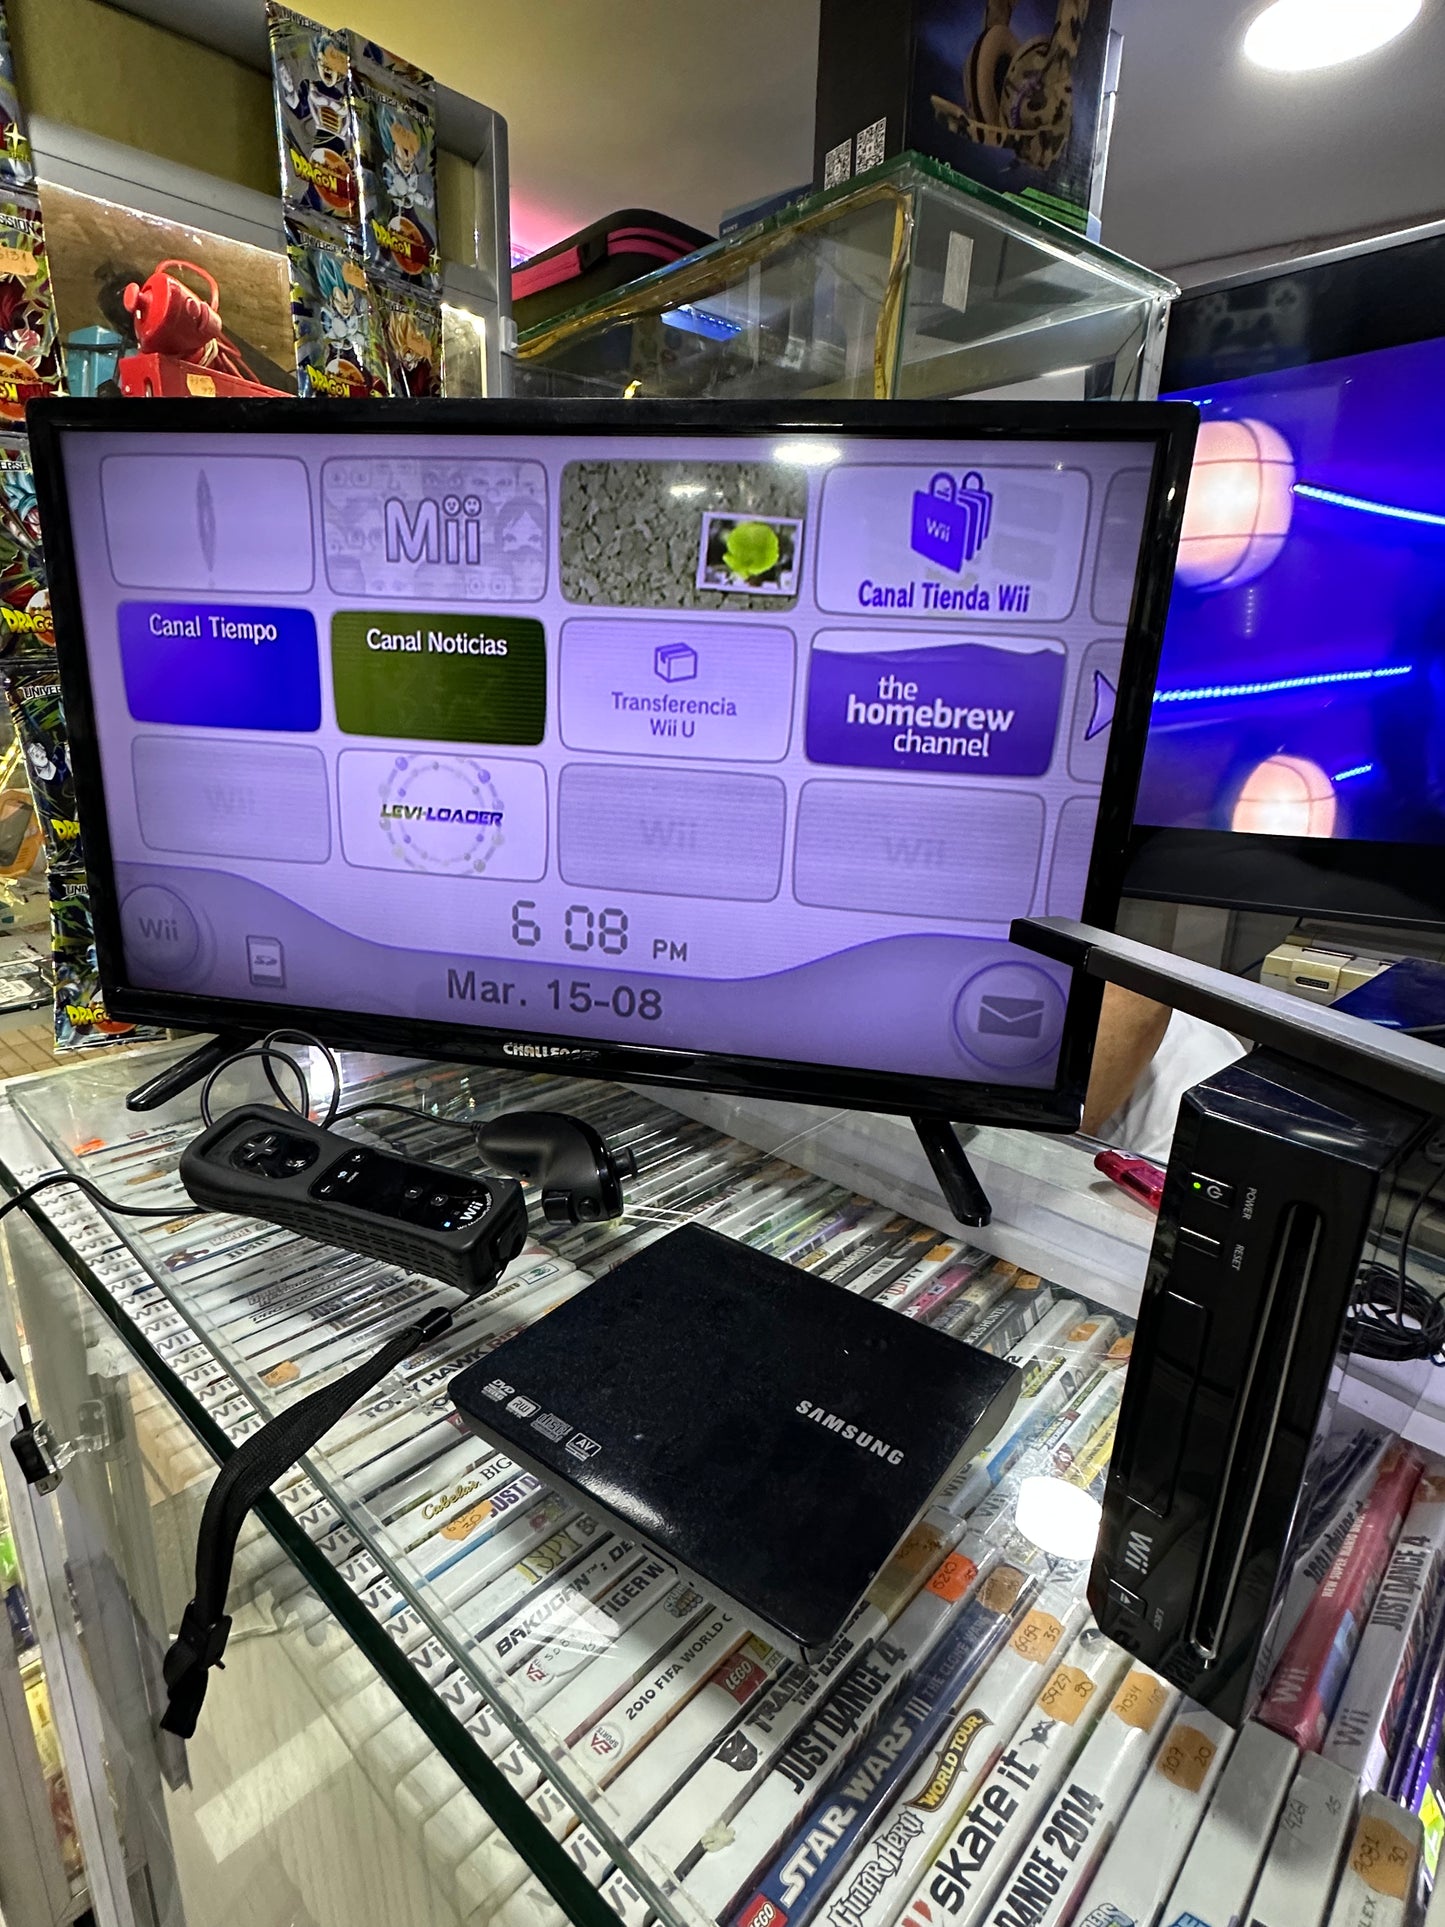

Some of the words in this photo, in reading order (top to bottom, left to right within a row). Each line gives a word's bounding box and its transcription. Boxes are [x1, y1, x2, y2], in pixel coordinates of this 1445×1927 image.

[290, 149, 338, 193] DRAGON
[0, 214, 35, 236] SSION
[371, 219, 412, 258] DRAGON
[307, 365, 350, 397] DRAGON
[384, 494, 482, 565] Mii
[926, 517, 952, 543] Wii
[858, 580, 915, 609] Canal
[922, 583, 990, 611] Tienda
[998, 586, 1030, 614] Wii
[1, 606, 54, 634] DRAGO
[149, 614, 201, 638] Canal
[209, 616, 278, 645] Tiempo
[366, 628, 421, 653] Canal
[428, 632, 508, 656] Noticias
[611, 693, 738, 718] Transferencia
[878, 677, 918, 701] the
[650, 719, 678, 738] Wii
[681, 720, 695, 739] U
[847, 693, 1014, 733] homebrew
[893, 731, 990, 759] channel
[51, 819, 80, 841] DRA
[138, 916, 179, 943] Wii
[652, 938, 688, 963] PM
[447, 968, 527, 1007] Mar.
[546, 978, 663, 1021] 15-08
[65, 1004, 112, 1027] DRAG
[460, 1201, 484, 1221] Wii
[1242, 1186, 1258, 1220] POWER
[1232, 1243, 1245, 1271] RESET
[421, 1348, 488, 1387] HAWK
[492, 1379, 516, 1394] DVD
[575, 1438, 596, 1451] AV
[796, 1400, 904, 1466] SAMSUNG
[479, 1457, 513, 1481] BIG
[489, 1482, 527, 1518] JUST
[1125, 1530, 1153, 1575] Wii
[1401, 1535, 1431, 1548] 4
[1382, 1550, 1428, 1595] DANCE
[599, 1572, 648, 1618] TIGER
[1370, 1592, 1411, 1632] JUST
[626, 1689, 656, 1721] 2010
[654, 1664, 684, 1691] FIFA
[681, 1619, 724, 1664] WORLD
[725, 1660, 753, 1691] LEGO
[774, 1726, 838, 1795] JUST
[816, 1662, 892, 1739] DANCE
[876, 1639, 908, 1667] 4
[1332, 1707, 1371, 1750] Wii
[918, 1751, 958, 1808] WORLD
[952, 1714, 984, 1753] TOUR
[780, 1802, 858, 1910] STAR
[840, 1724, 913, 1803] WARS
[905, 1696, 934, 1722] III
[929, 1784, 1019, 1916] skate
[997, 1747, 1041, 1791] it
[993, 1845, 1069, 1927] DANCE
[1042, 1783, 1105, 1863] 2014
